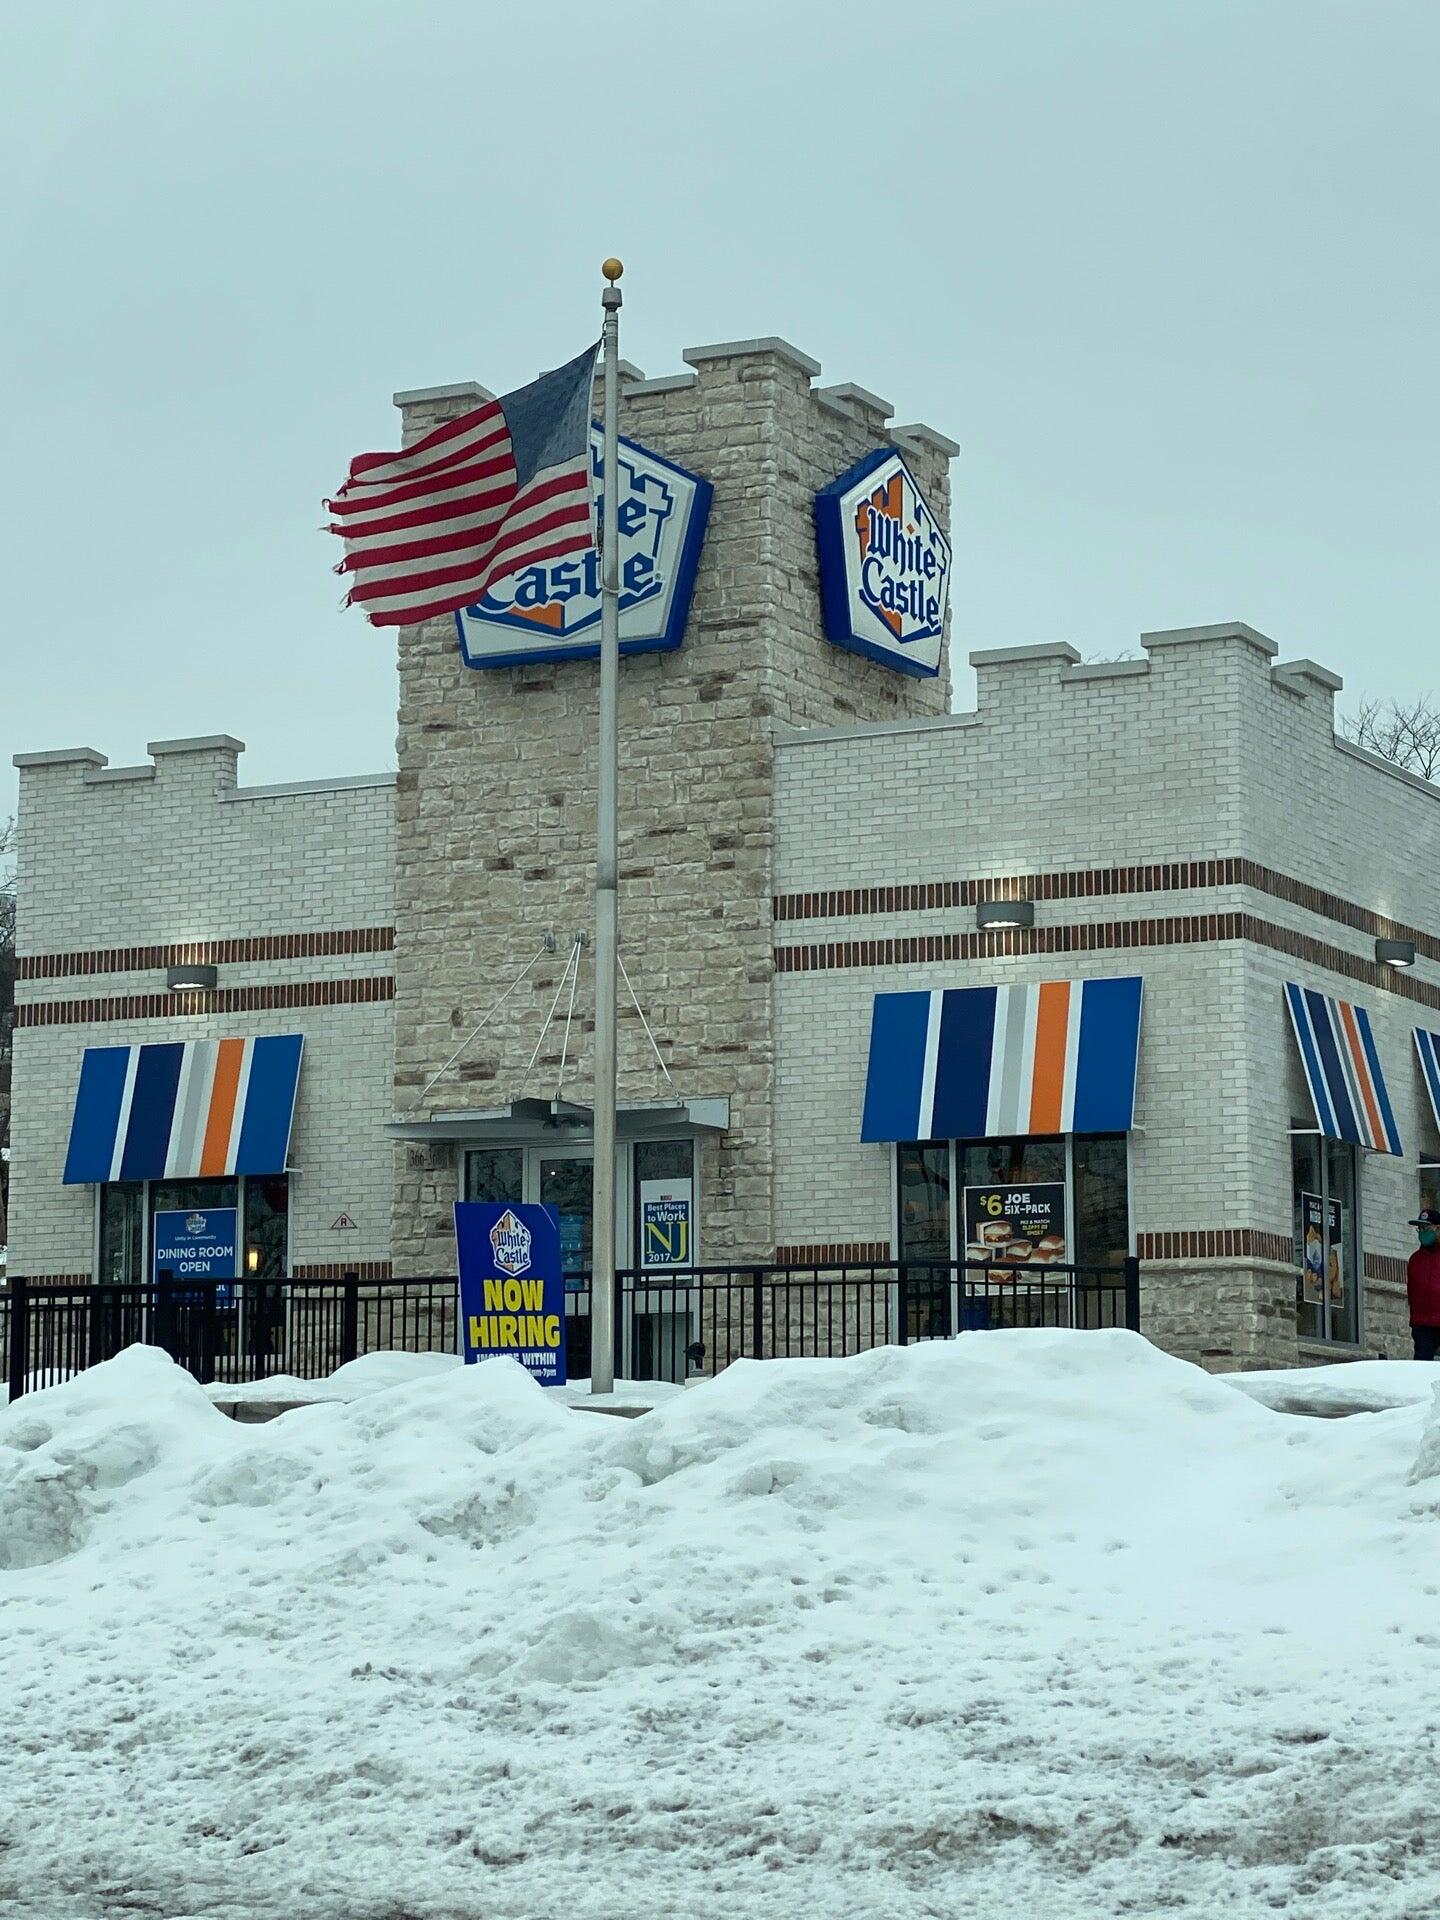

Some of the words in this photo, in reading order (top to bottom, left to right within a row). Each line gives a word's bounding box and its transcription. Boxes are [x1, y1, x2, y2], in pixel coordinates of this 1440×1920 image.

[867, 507, 936, 581] White
[481, 549, 654, 606] aste
[862, 556, 939, 629] Castle
[980, 1194, 1002, 1216] $6
[1005, 1193, 1031, 1204] JOE
[657, 1211, 685, 1222] Work
[1004, 1203, 1051, 1215] SIX-PACK
[497, 1230, 526, 1249] White
[645, 1221, 688, 1262] NJ
[157, 1248, 196, 1259] DINING
[198, 1246, 233, 1258] ROOM
[496, 1248, 528, 1264] Castle
[648, 1254, 671, 1262] 2017
[179, 1261, 211, 1272] OPEN
[483, 1279, 544, 1312] NOW
[469, 1315, 561, 1348] HIRING
[522, 1352, 557, 1365] WITHIN
